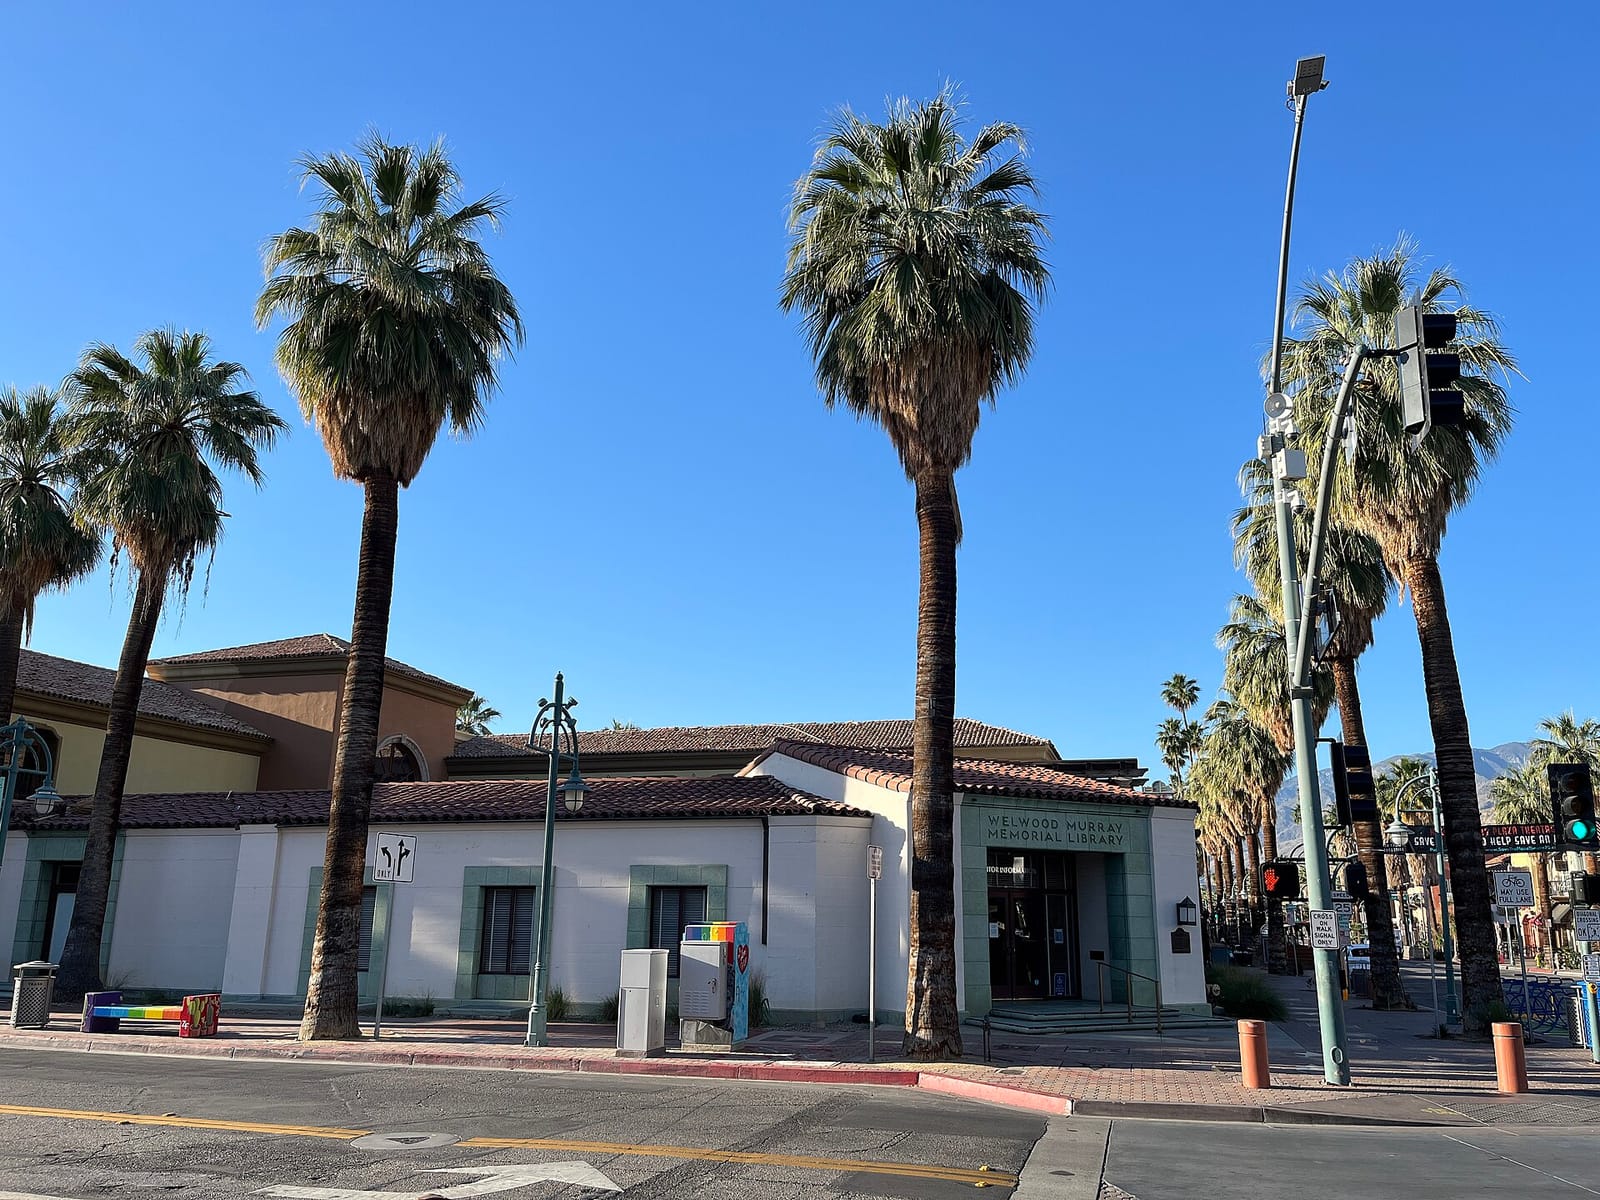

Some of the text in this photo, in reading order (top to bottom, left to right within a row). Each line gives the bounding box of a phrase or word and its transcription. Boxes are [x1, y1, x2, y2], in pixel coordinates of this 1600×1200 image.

[988, 816, 1122, 833] WELWOOD MURRAY
[988, 828, 1123, 846] MEMORIAL LIBRARY
[1413, 836, 1435, 847] SAVE
[1489, 836, 1512, 846] HELP
[1514, 835, 1537, 845] SAVE
[1538, 834, 1551, 844] AN
[377, 870, 391, 878] ONLY
[1335, 903, 1351, 913] 25
[1577, 928, 1587, 937] OK
